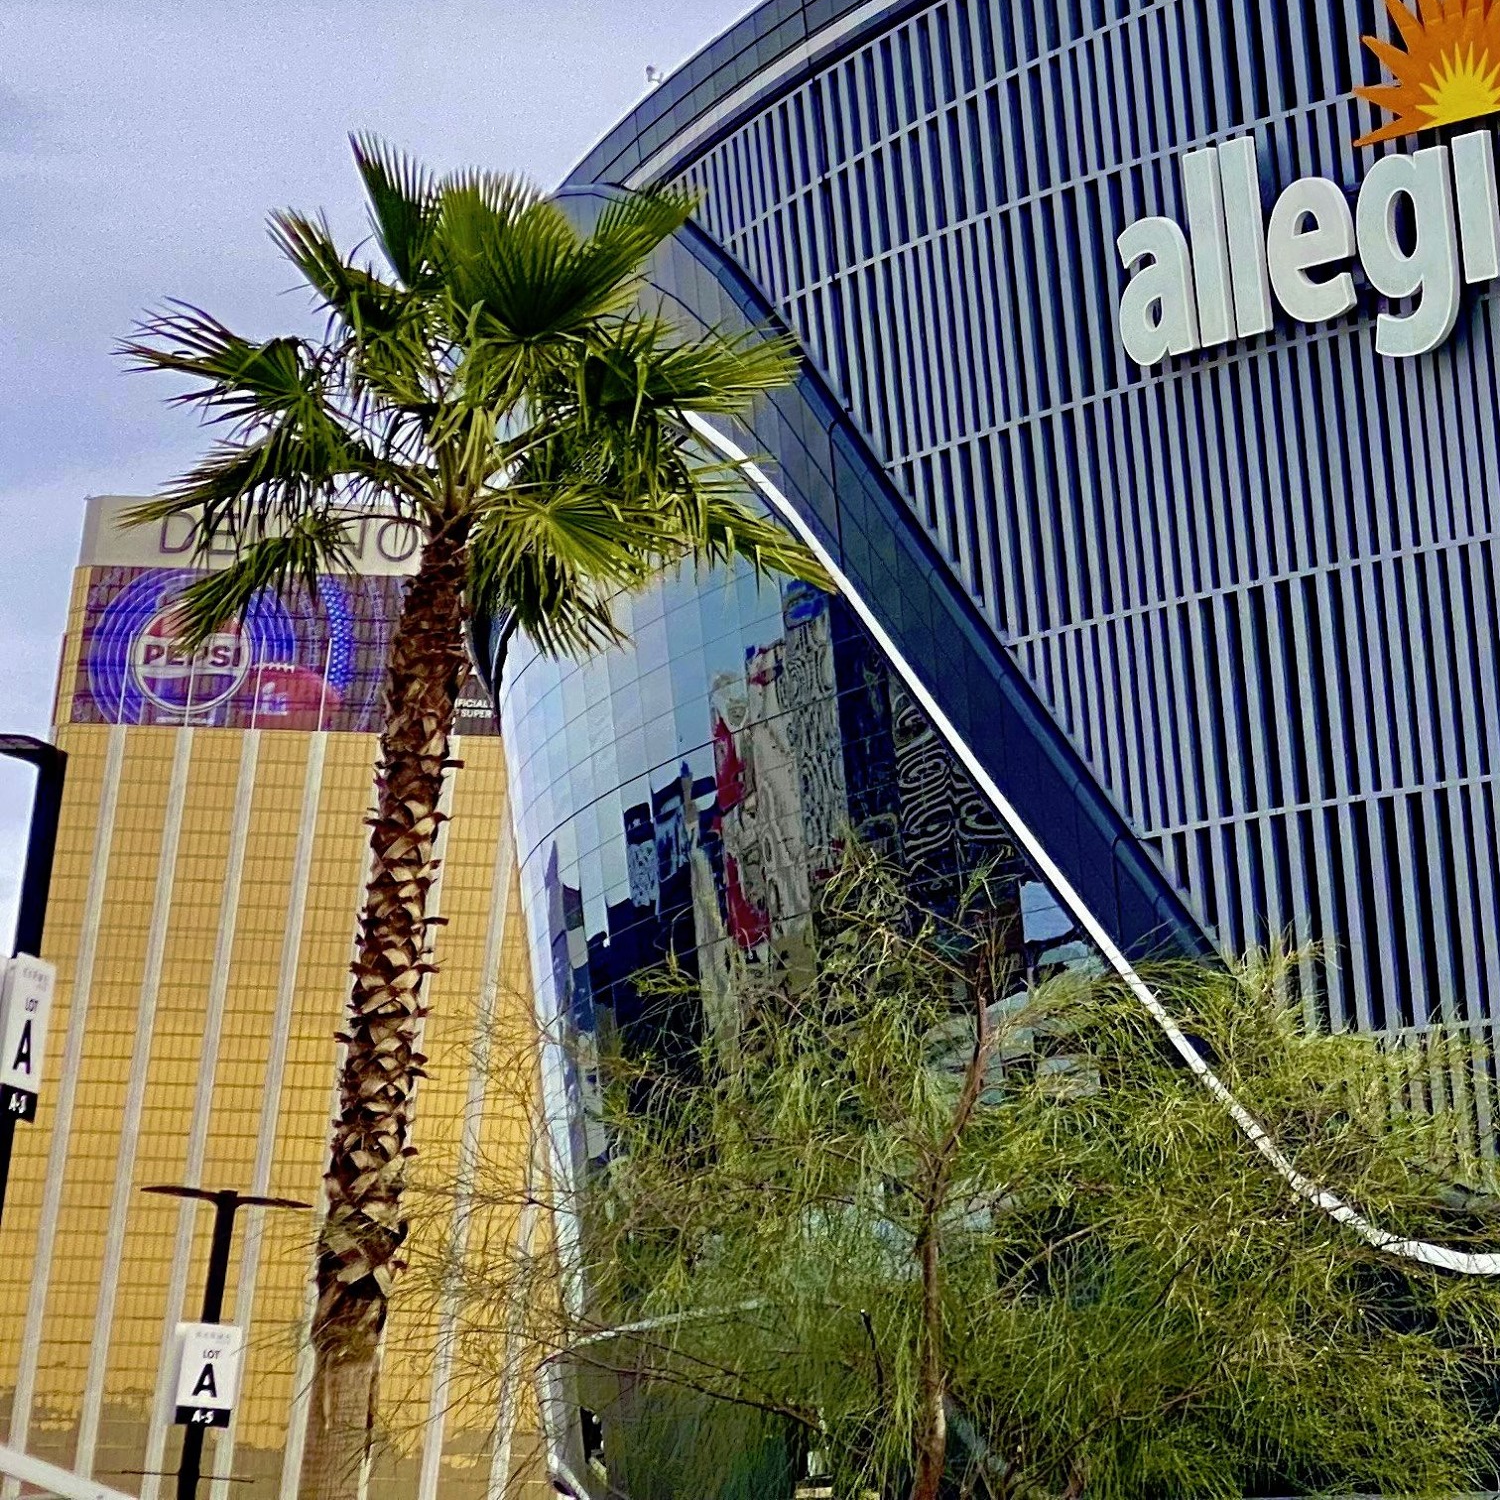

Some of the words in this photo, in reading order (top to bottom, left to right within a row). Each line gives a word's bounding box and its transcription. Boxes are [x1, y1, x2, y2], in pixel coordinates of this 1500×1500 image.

[12, 1018, 32, 1075] A
[202, 1348, 221, 1360] LOT
[191, 1363, 218, 1398] A
